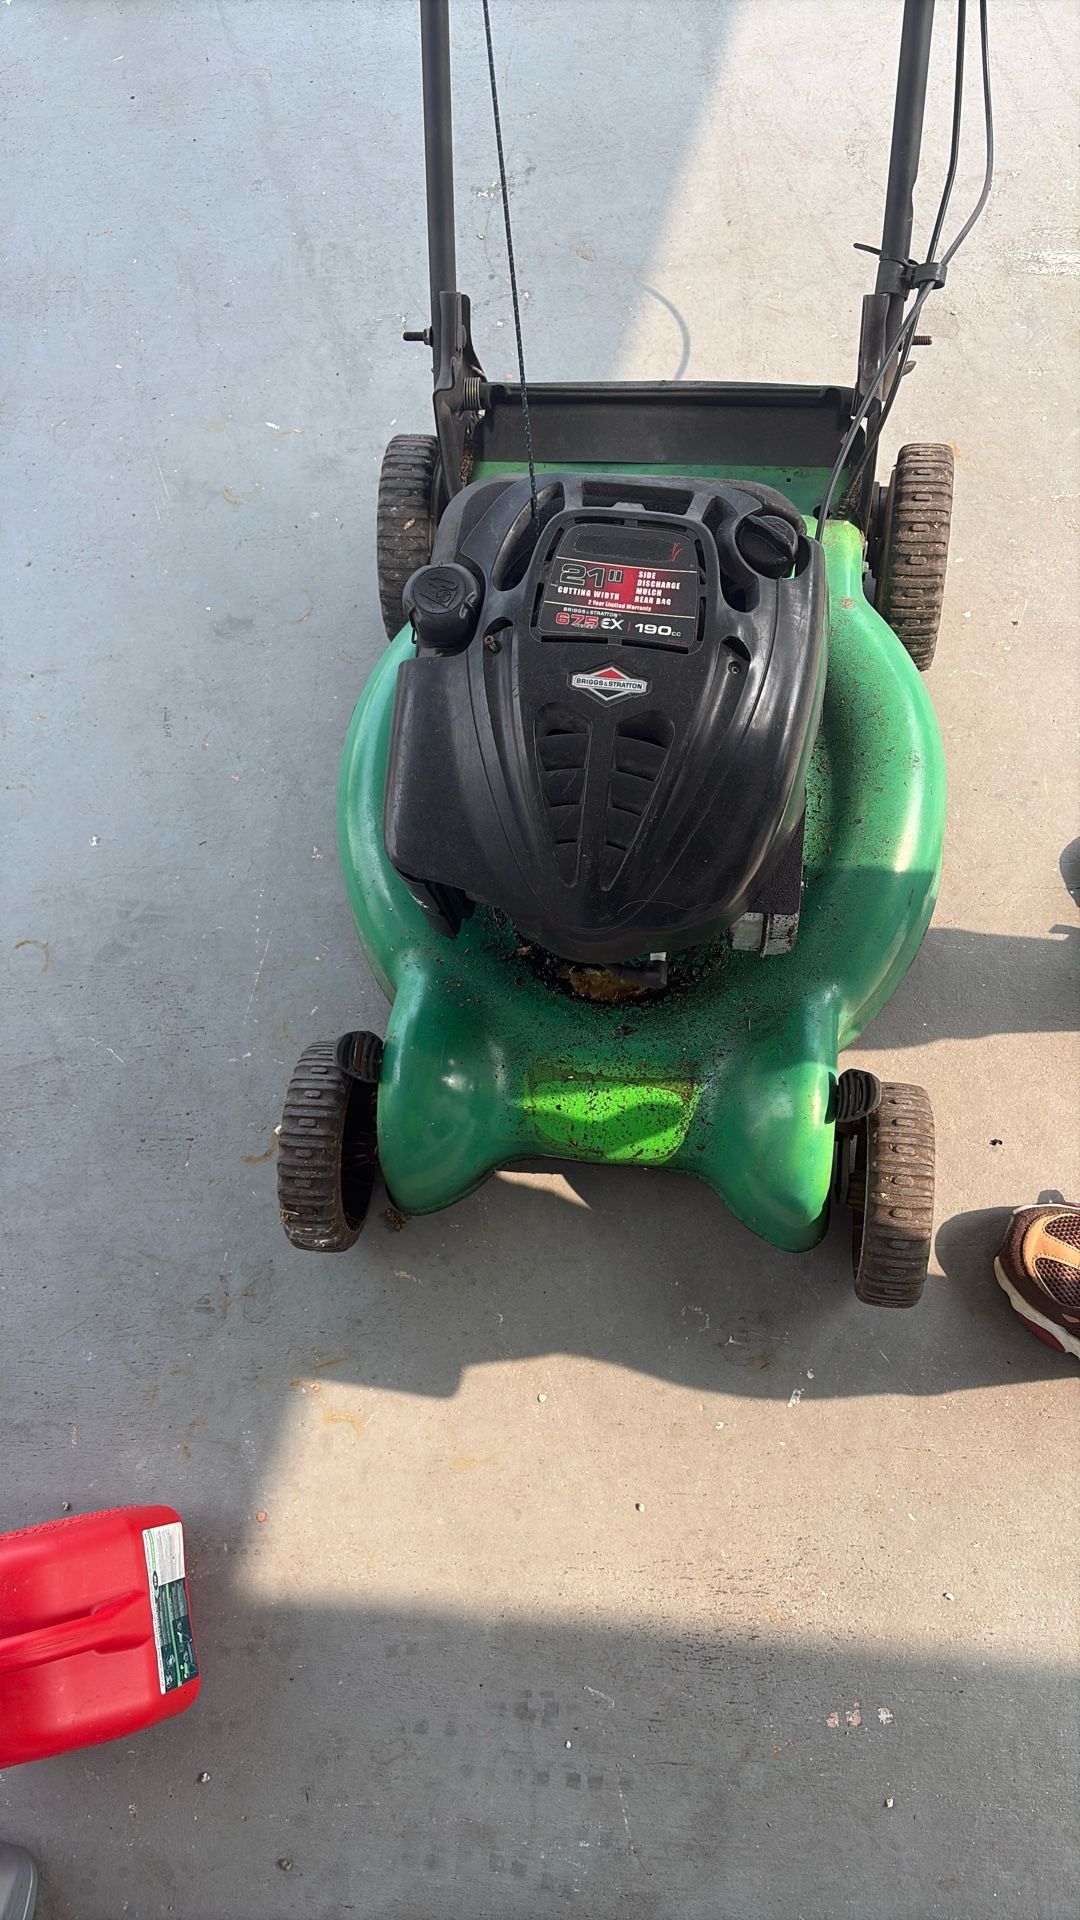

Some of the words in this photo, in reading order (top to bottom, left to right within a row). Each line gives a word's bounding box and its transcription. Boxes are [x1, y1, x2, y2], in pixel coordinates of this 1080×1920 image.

[638, 571, 656, 579] SIDE
[637, 579, 681, 589] DISCHARGE
[557, 586, 591, 597] CUTTING
[593, 590, 620, 600] WIDTH
[635, 587, 662, 596] MULCH
[634, 595, 654, 604] REAR
[656, 597, 672, 605] BAG
[605, 601, 625, 609] Limited
[626, 603, 652, 612] Warranty
[555, 612, 599, 627] 675
